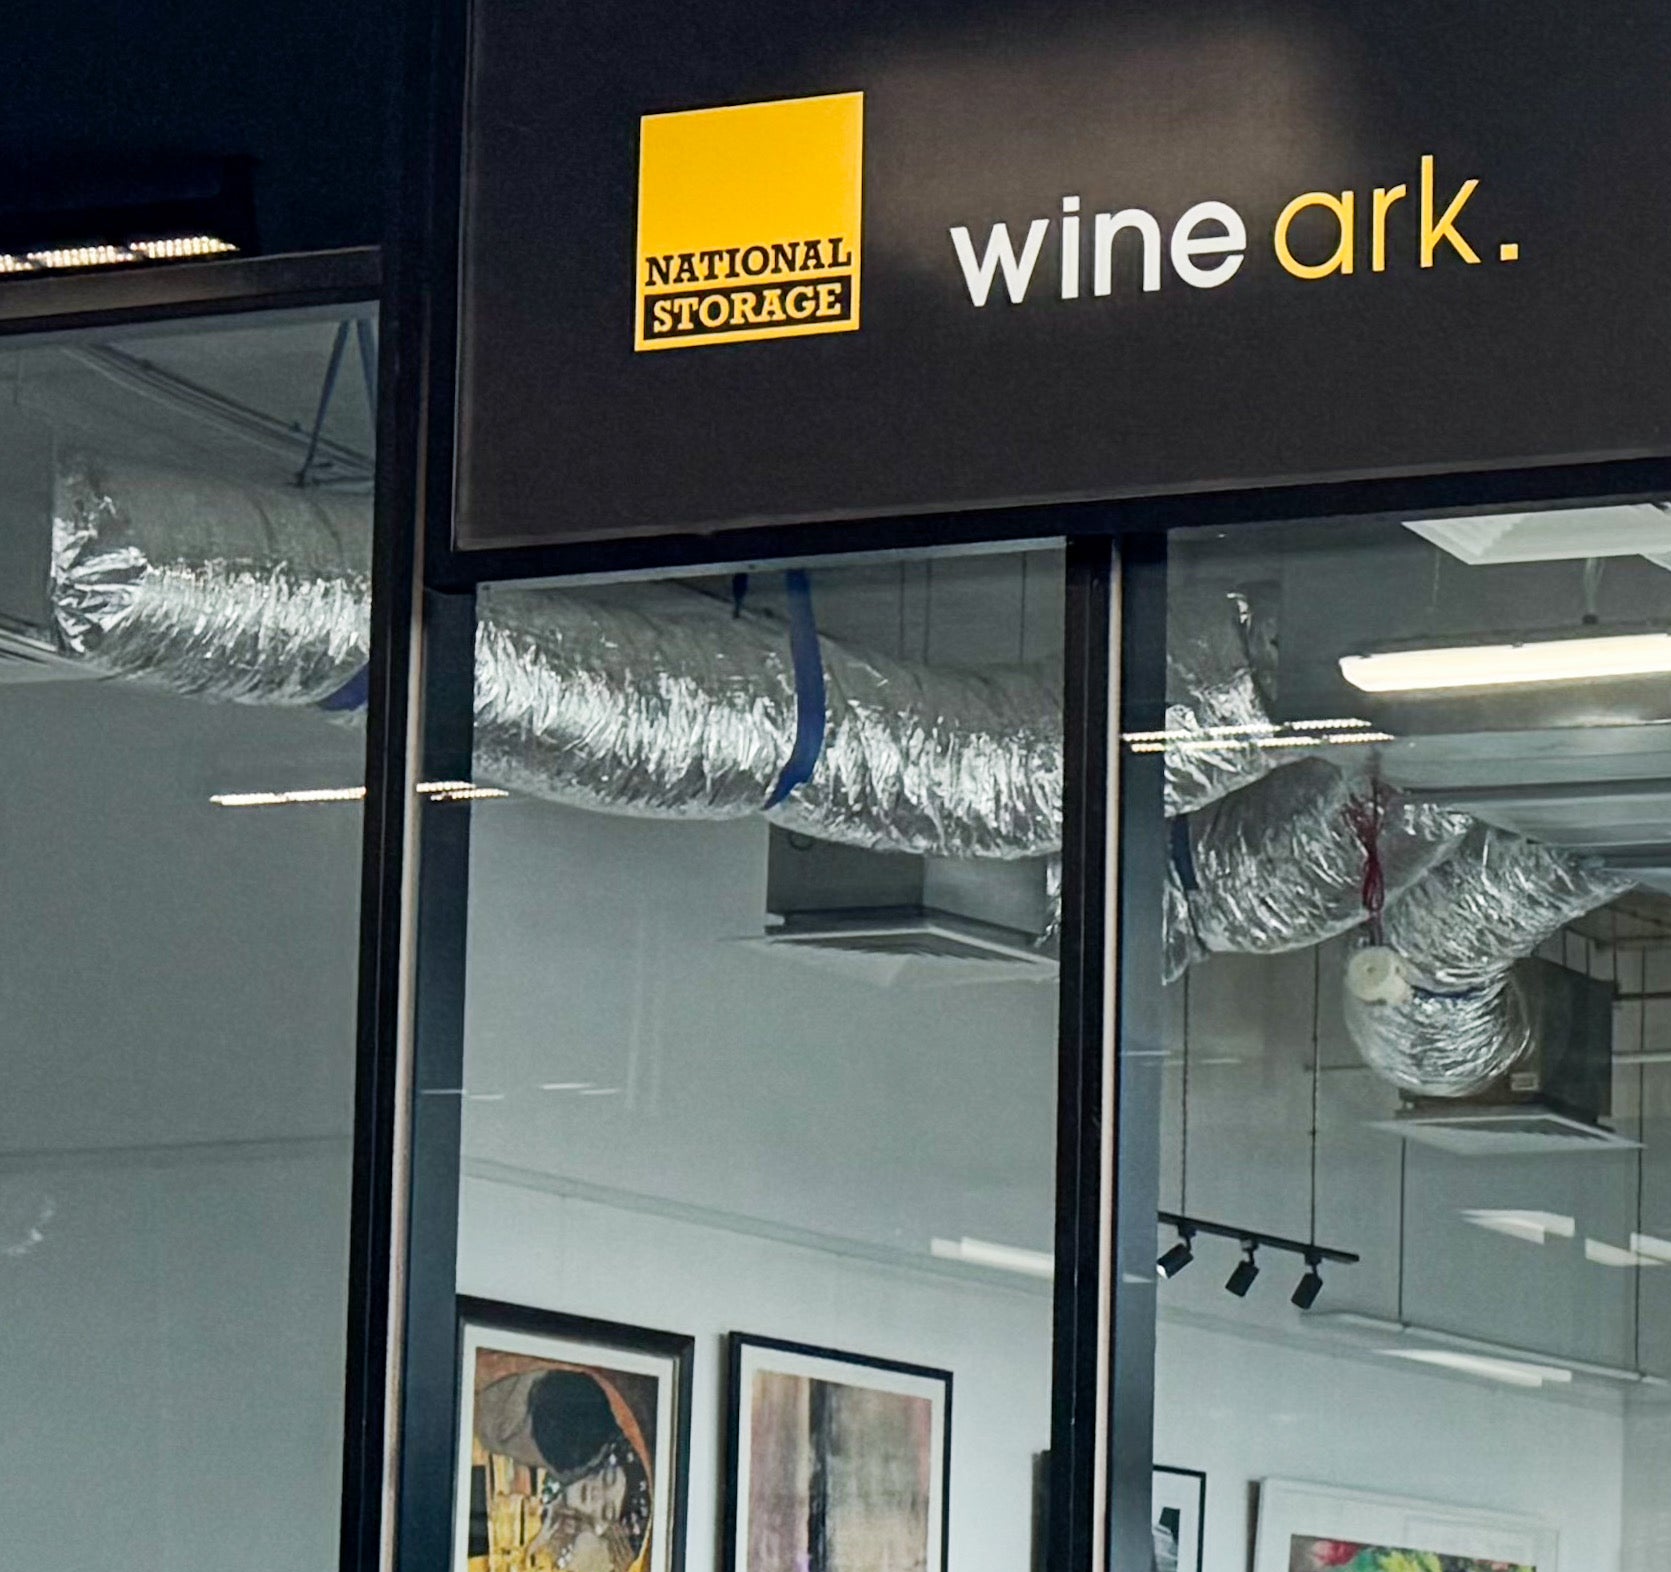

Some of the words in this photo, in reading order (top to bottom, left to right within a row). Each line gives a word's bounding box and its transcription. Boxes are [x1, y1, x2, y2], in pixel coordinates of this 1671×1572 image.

[950, 196, 1247, 307] wine
[1275, 155, 1518, 279] ark.
[645, 238, 851, 286] NATIONAL
[653, 283, 841, 333] STORAGE
